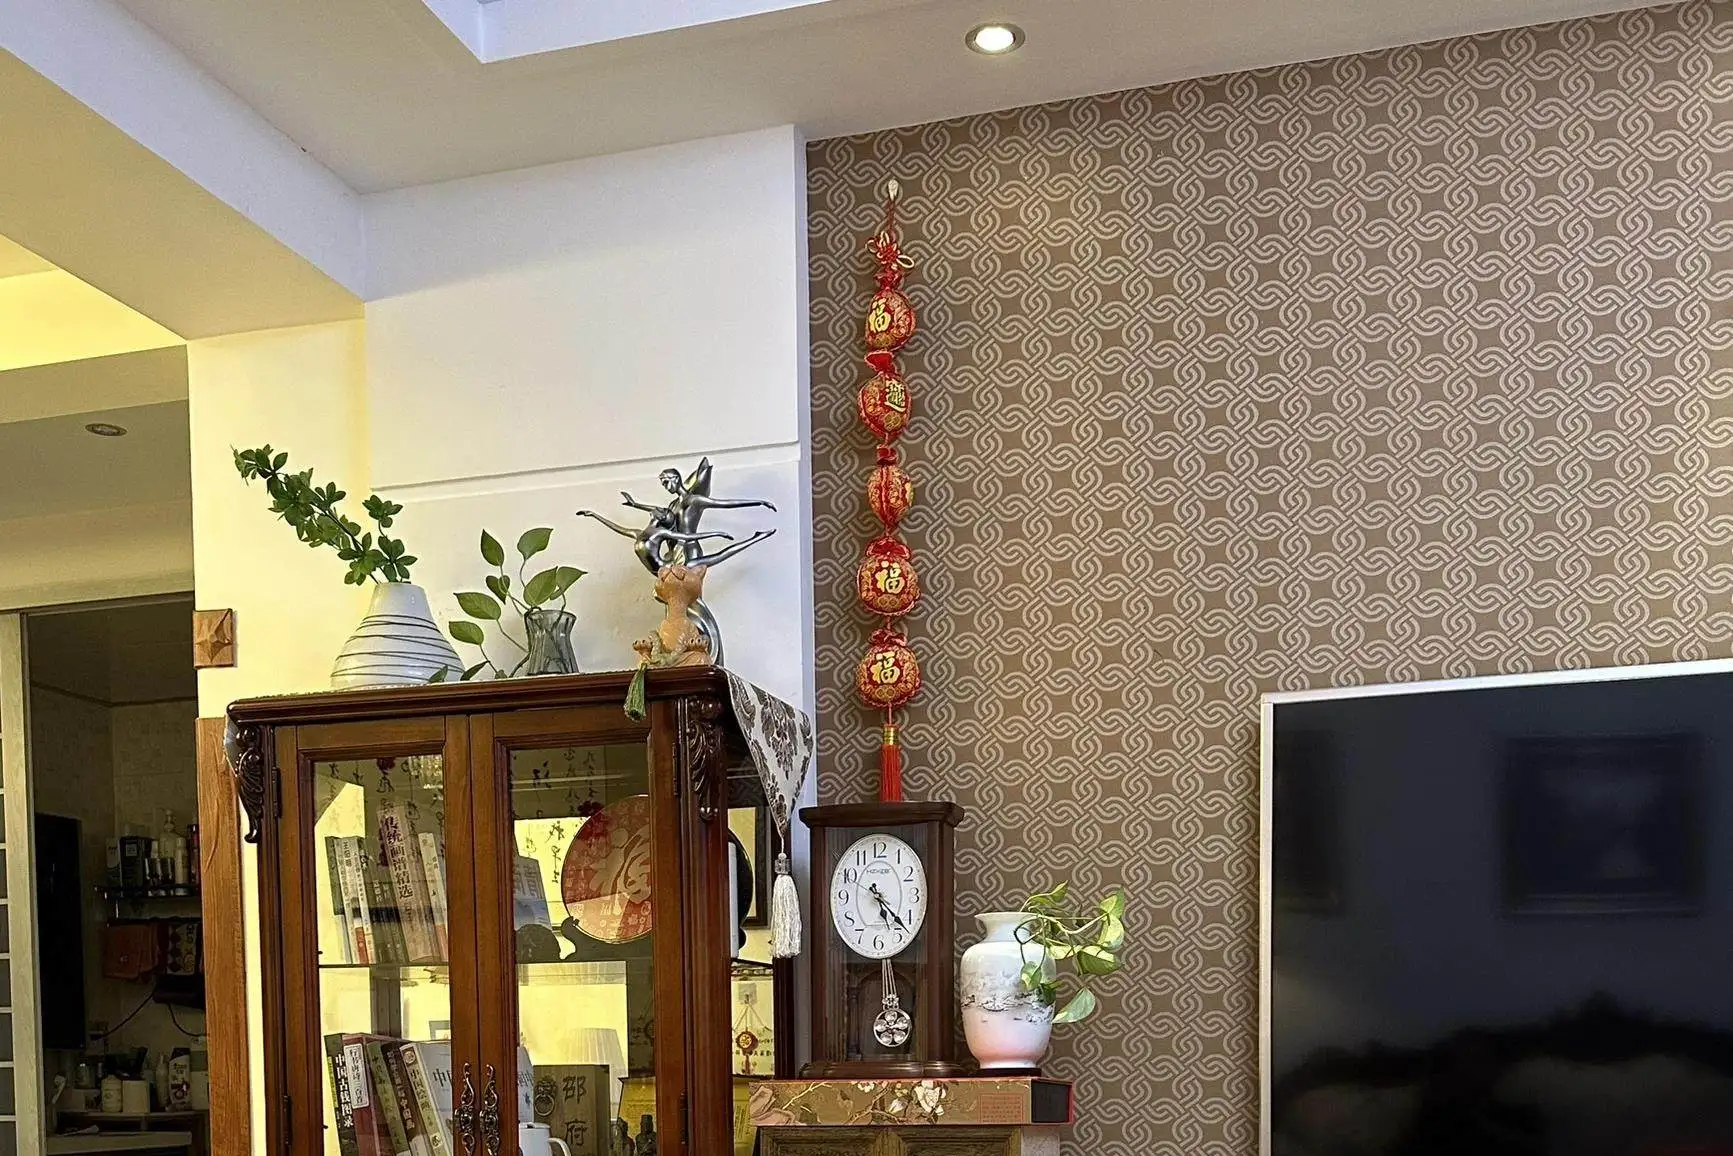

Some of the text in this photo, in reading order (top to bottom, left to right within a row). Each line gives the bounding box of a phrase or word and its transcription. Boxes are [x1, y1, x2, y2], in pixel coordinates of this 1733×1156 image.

[868, 298, 892, 333] 福
[875, 561, 905, 594] 福
[870, 651, 900, 683] 福
[857, 850, 866, 866] 11
[873, 842, 887, 858] 12
[896, 848, 900, 864] 1
[843, 868, 857, 884] 10
[903, 866, 914, 882] 2
[838, 889, 849, 905] 9
[909, 887, 920, 903] 3
[844, 911, 855, 927] 8
[904, 909, 912, 925] 4
[855, 929, 864, 944] 7
[873, 935, 884, 950] 6
[892, 927, 903, 944] 5
